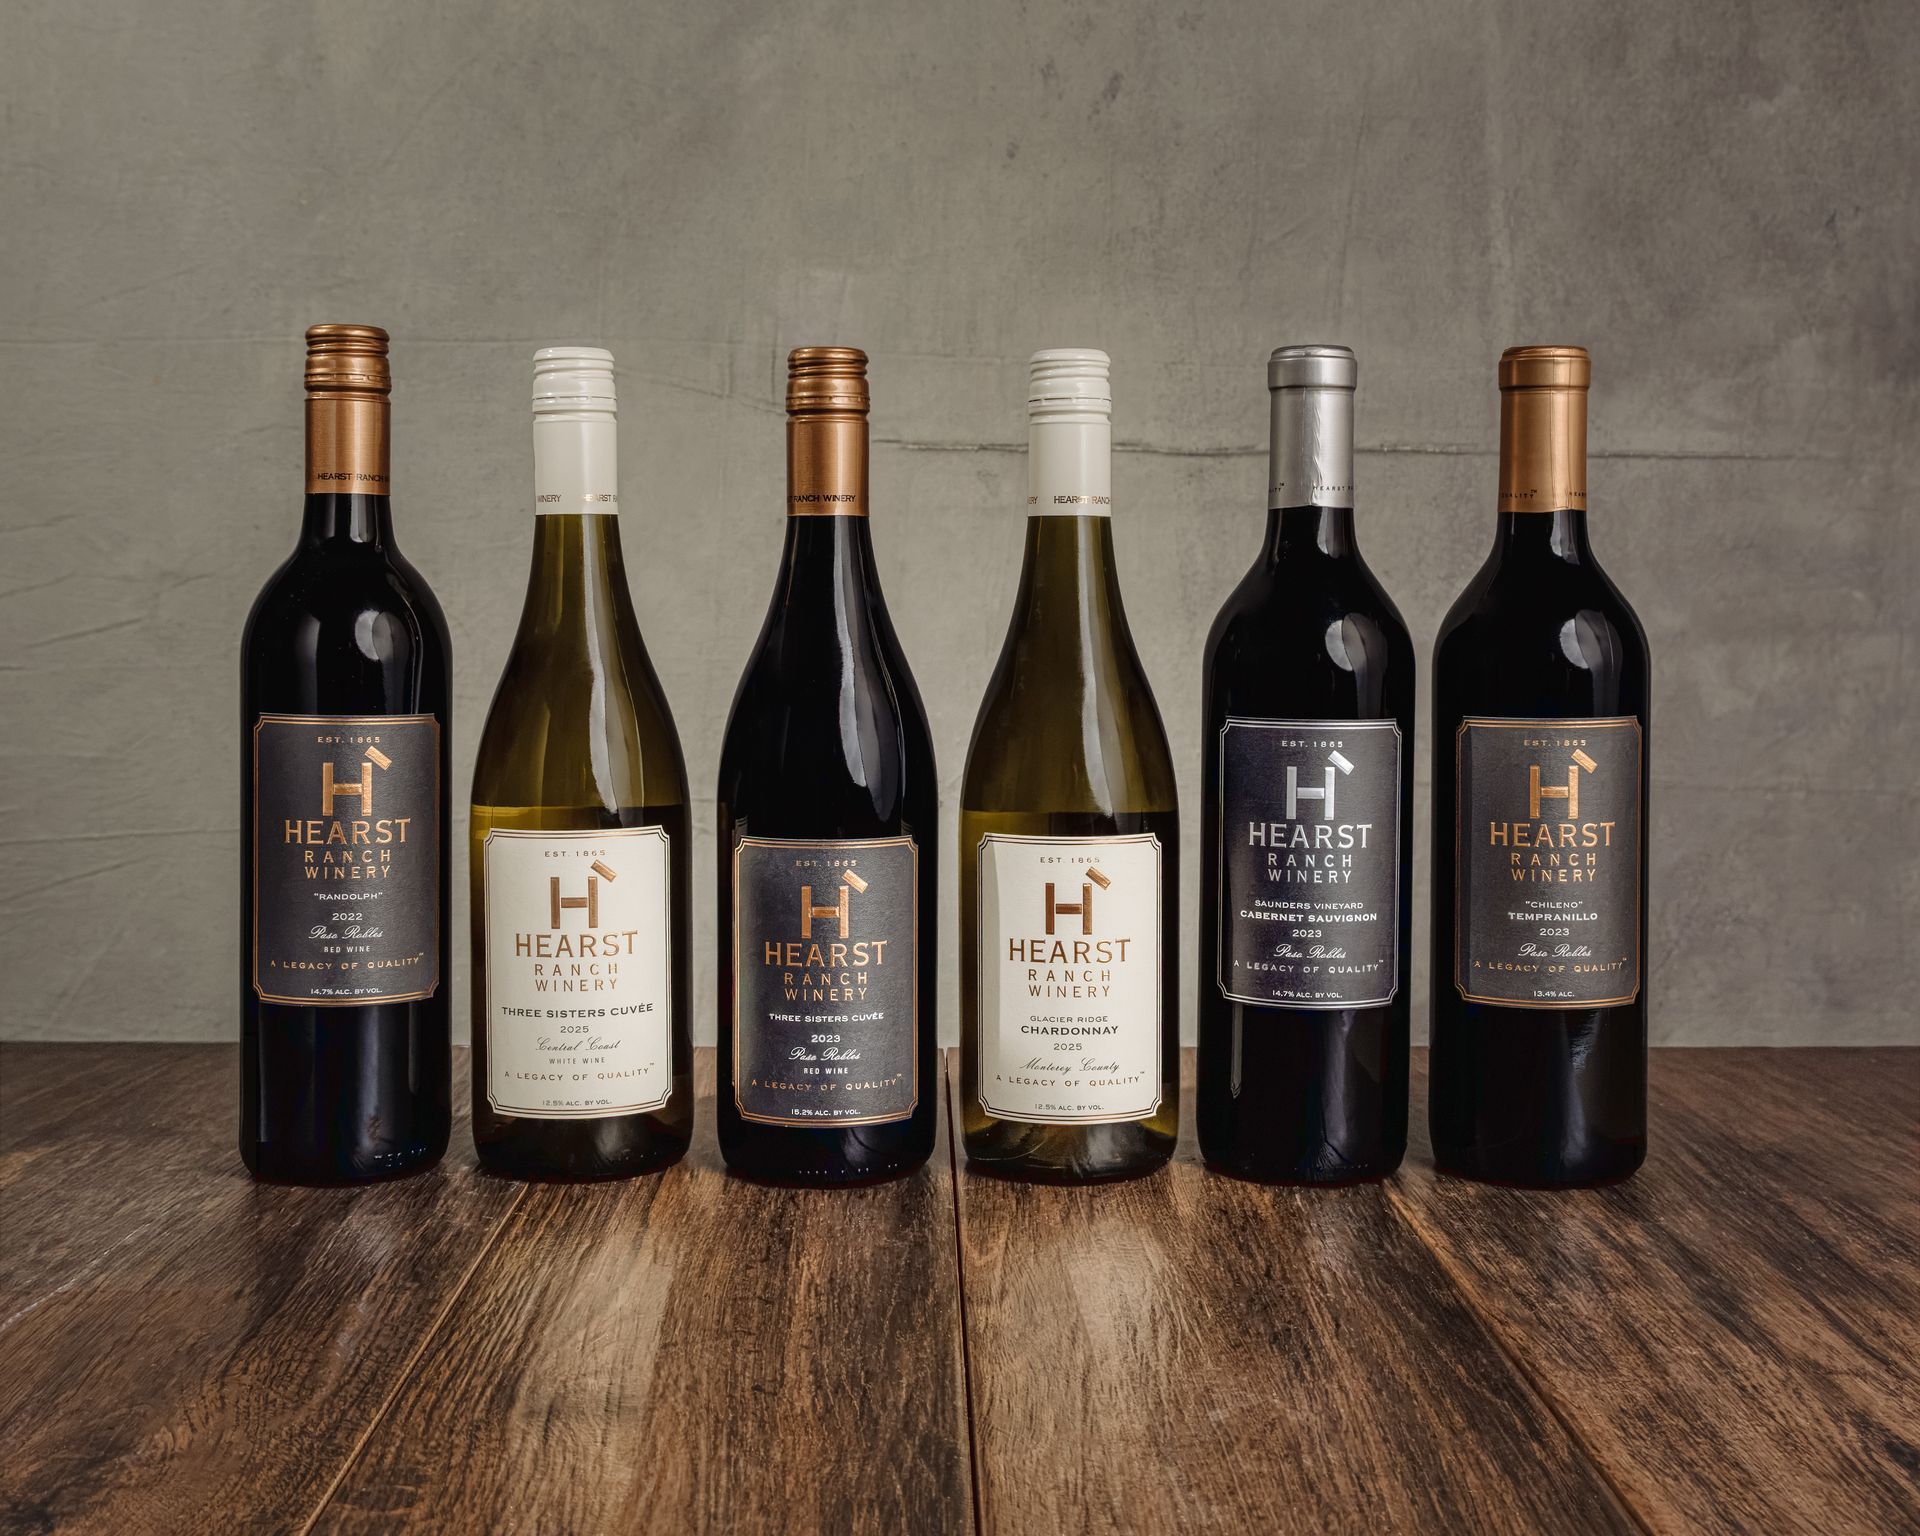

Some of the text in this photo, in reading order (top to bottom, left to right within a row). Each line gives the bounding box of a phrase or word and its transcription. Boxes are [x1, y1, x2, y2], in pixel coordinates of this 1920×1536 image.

[1523, 739, 1552, 747] EST.
[284, 818, 411, 845] HEARST
[1248, 822, 1373, 849] HEARST
[1490, 821, 1616, 848] HEARST
[304, 851, 391, 863] RANCH
[1268, 854, 1352, 867] RANCH
[1511, 853, 1596, 866] RANCH
[305, 865, 391, 880] WINERY
[1268, 869, 1352, 883] WINERY
[1511, 869, 1596, 882] WINERY
[314, 892, 383, 900] "RANDOLPH"
[1255, 900, 1311, 910] SAUNDERS
[1525, 901, 1583, 909] "CHILENO"
[332, 913, 363, 921] 2022
[1240, 910, 1377, 923] CABERNET SAUVIGNON
[1508, 911, 1598, 921] TEMPRANILLO
[308, 925, 384, 939] Paso Robles
[1292, 929, 1322, 937] 2023
[1540, 928, 1570, 936] 2023
[515, 930, 638, 958] HEARST
[1009, 937, 1131, 964] HEARST
[1518, 942, 1592, 957] Paso Robles
[765, 940, 888, 968] HEARST
[1274, 944, 1347, 959] Paso Robles
[283, 961, 332, 970] LEGACY
[367, 956, 419, 969] QUALITY
[534, 963, 618, 976] RANCH
[1246, 962, 1294, 973] LEGACY
[1328, 964, 1379, 973] QUALITY
[1489, 962, 1540, 972] LEGACY
[1574, 961, 1623, 972] QUALITY
[784, 972, 867, 986] RANCH
[1028, 968, 1111, 982] RANCH
[535, 978, 617, 992] WINERY
[1028, 985, 1110, 998] WINERY
[784, 987, 867, 1002] WINERY
[501, 1002, 654, 1018] THREE SISTERS CUVÉE
[769, 1011, 884, 1023] THREE SISTERS CUVÉE
[1030, 1015, 1073, 1023] GLACIER
[560, 1025, 589, 1033] 2025
[1021, 1025, 1119, 1035] CHARDONNAY
[536, 1036, 621, 1051] Central Coast
[811, 1035, 841, 1043] 2023
[788, 1046, 861, 1061] Paso Robles
[1053, 1043, 1083, 1051] 2025
[1019, 1057, 1120, 1075] Monterey County
[516, 1072, 563, 1081] LEGACY
[597, 1067, 649, 1080] QUALITY
[764, 1080, 812, 1090] LEGACY
[845, 1079, 897, 1090] QUALITY
[1009, 1076, 1056, 1086] LEGACY
[1089, 1076, 1140, 1086] QUALITY
